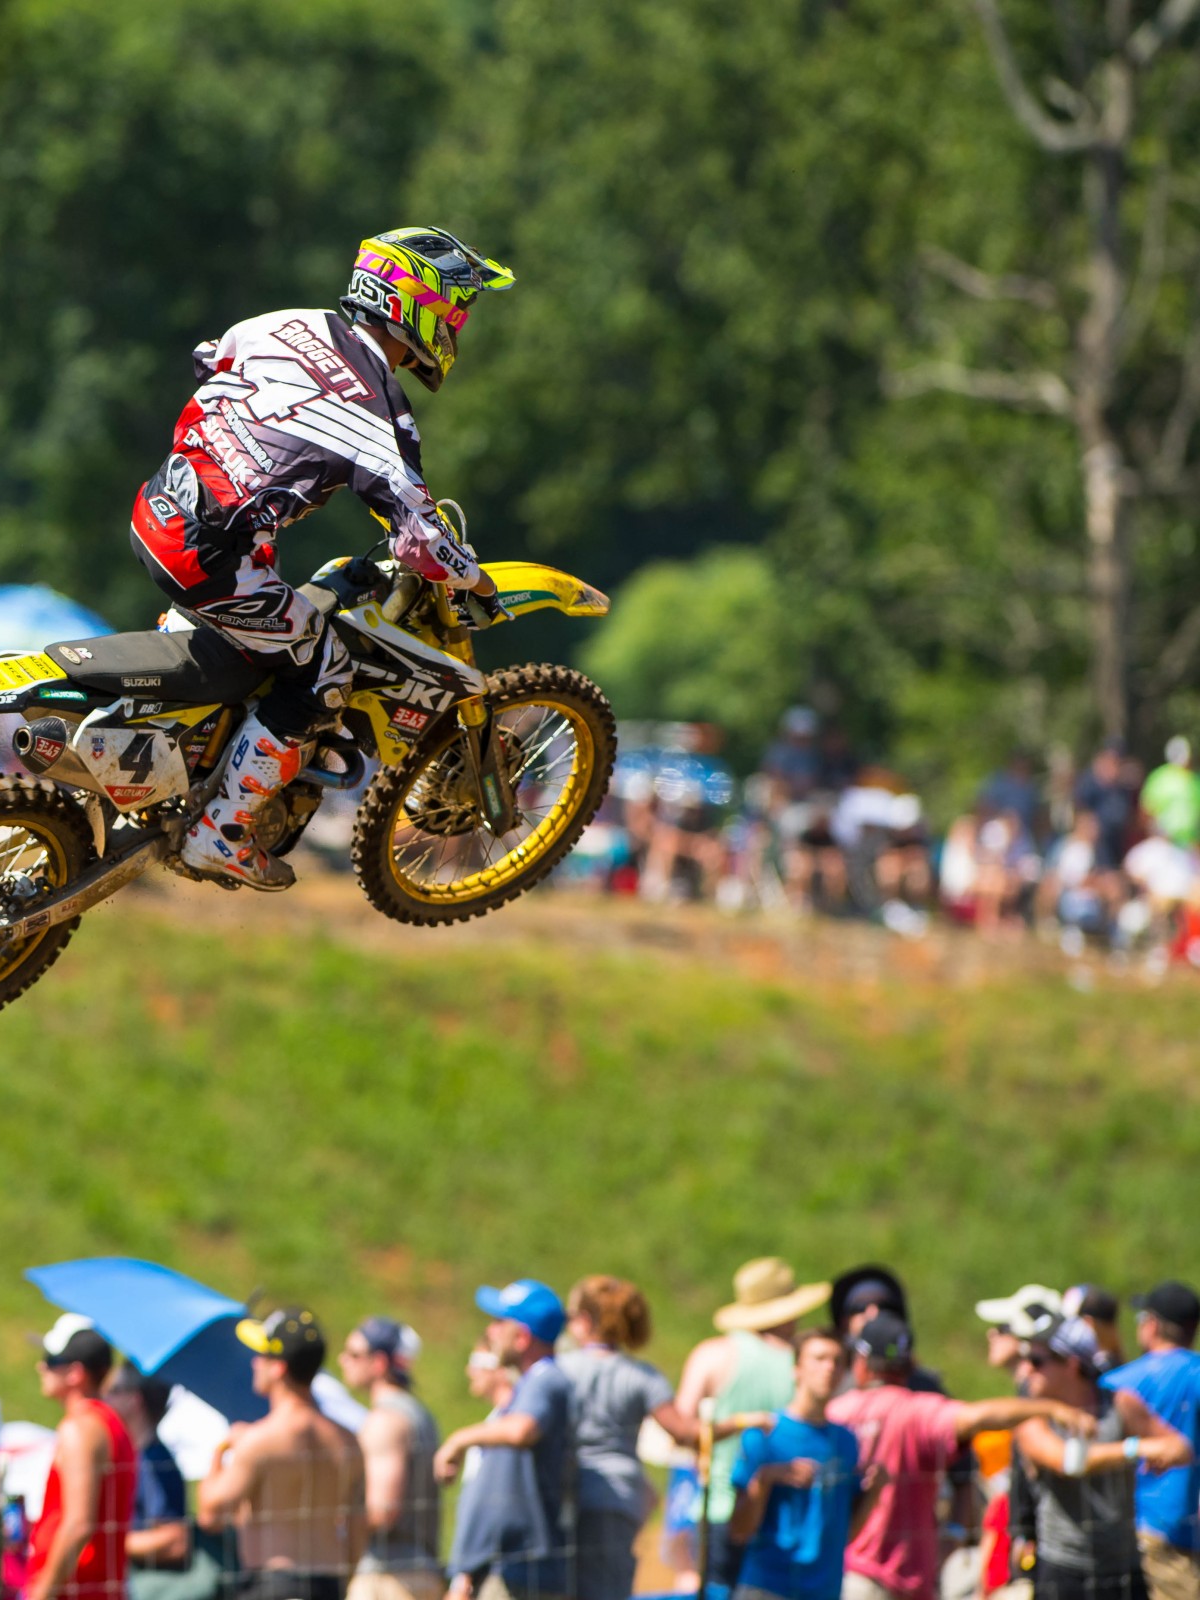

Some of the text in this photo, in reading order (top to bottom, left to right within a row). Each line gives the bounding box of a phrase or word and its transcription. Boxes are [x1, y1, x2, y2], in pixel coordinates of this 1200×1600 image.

[349, 270, 403, 323] UST1
[277, 321, 370, 400] BAGGETT
[242, 357, 326, 422] 4
[199, 414, 262, 491] SUZUKI
[224, 408, 275, 474] YOSHIMURA
[436, 545, 468, 579] SUZ
[498, 591, 532, 606] OTOREX
[218, 614, 287, 628] ONEAL
[122, 677, 162, 688] SUZUKI
[138, 702, 163, 714] BB4
[118, 733, 156, 784] 4
[113, 787, 148, 798] SUZUKI
